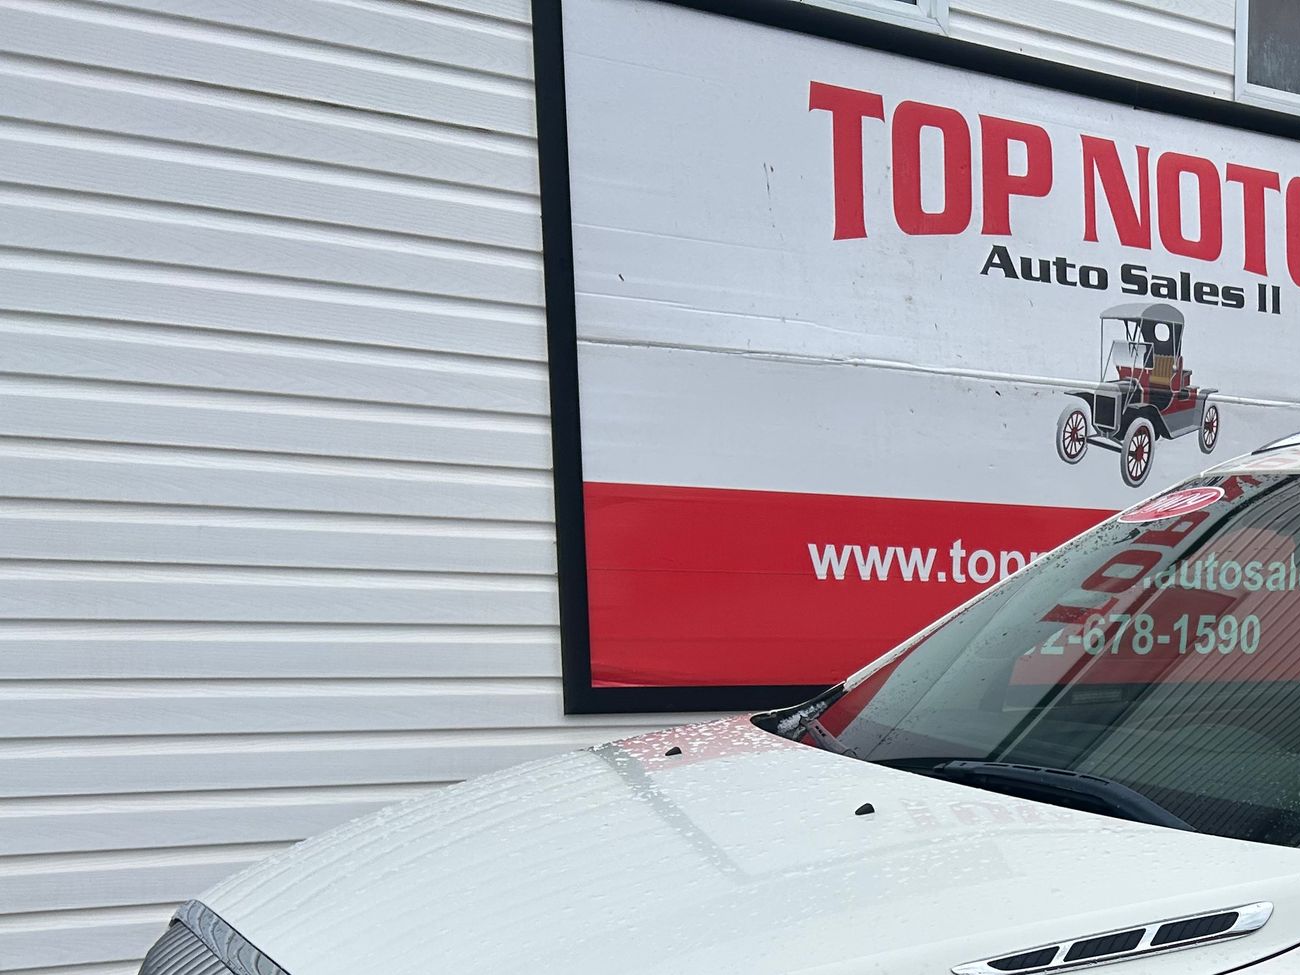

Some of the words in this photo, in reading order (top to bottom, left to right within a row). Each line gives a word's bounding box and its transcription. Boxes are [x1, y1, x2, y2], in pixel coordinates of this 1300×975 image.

[809, 80, 1053, 240] TOP
[980, 244, 1108, 290] Auto
[1120, 263, 1245, 309] Sales
[1257, 283, 1281, 314] II
